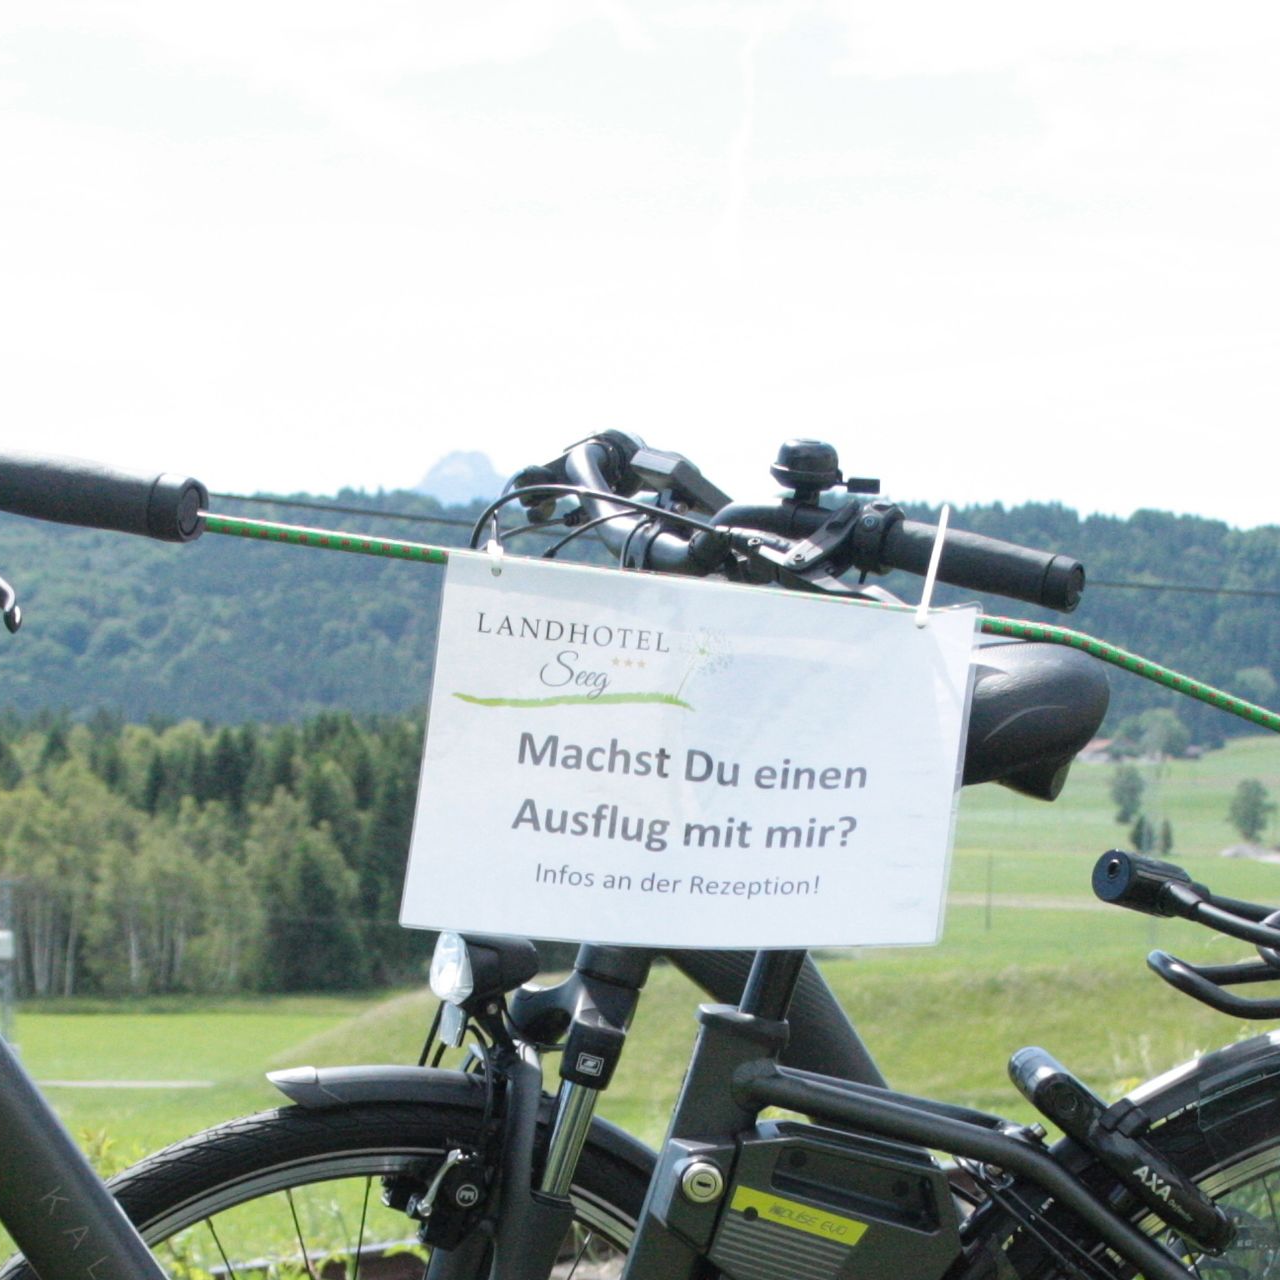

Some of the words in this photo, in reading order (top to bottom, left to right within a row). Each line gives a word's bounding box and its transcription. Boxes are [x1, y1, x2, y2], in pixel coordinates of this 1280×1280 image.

[477, 612, 671, 653] LANDHOTEL
[539, 650, 612, 700] Seeg
[517, 731, 671, 778] Machst
[684, 748, 740, 788] Du
[754, 759, 868, 790] einen
[511, 798, 670, 853] Ausflug
[682, 813, 752, 849] mit
[764, 815, 859, 849] mir?
[534, 862, 595, 889] Infos
[602, 873, 633, 892] an
[640, 871, 680, 894] der
[689, 874, 821, 900] Rezeption!
[1131, 1164, 1174, 1201] AXA
